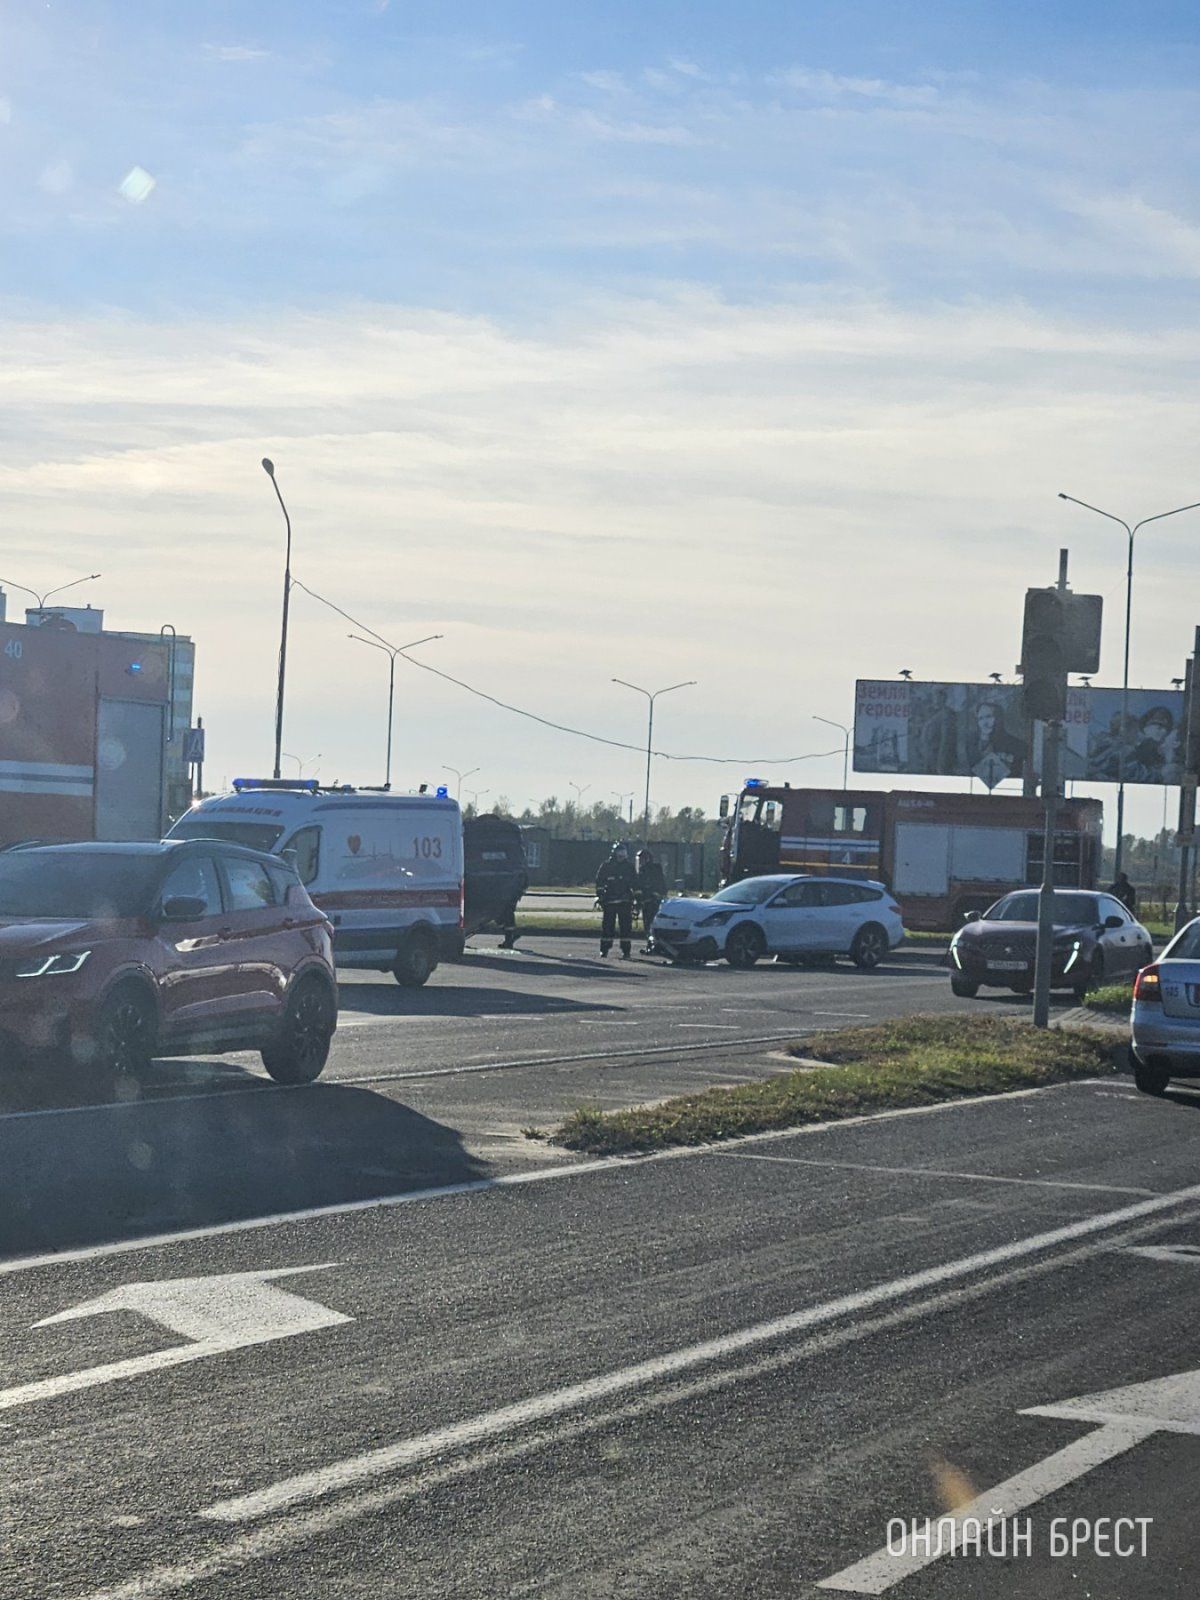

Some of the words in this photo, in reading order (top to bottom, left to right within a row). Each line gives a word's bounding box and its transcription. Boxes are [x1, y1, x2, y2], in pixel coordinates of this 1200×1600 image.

[5, 640, 22, 658] 40
[858, 703, 910, 720] героев
[413, 836, 441, 858] 103
